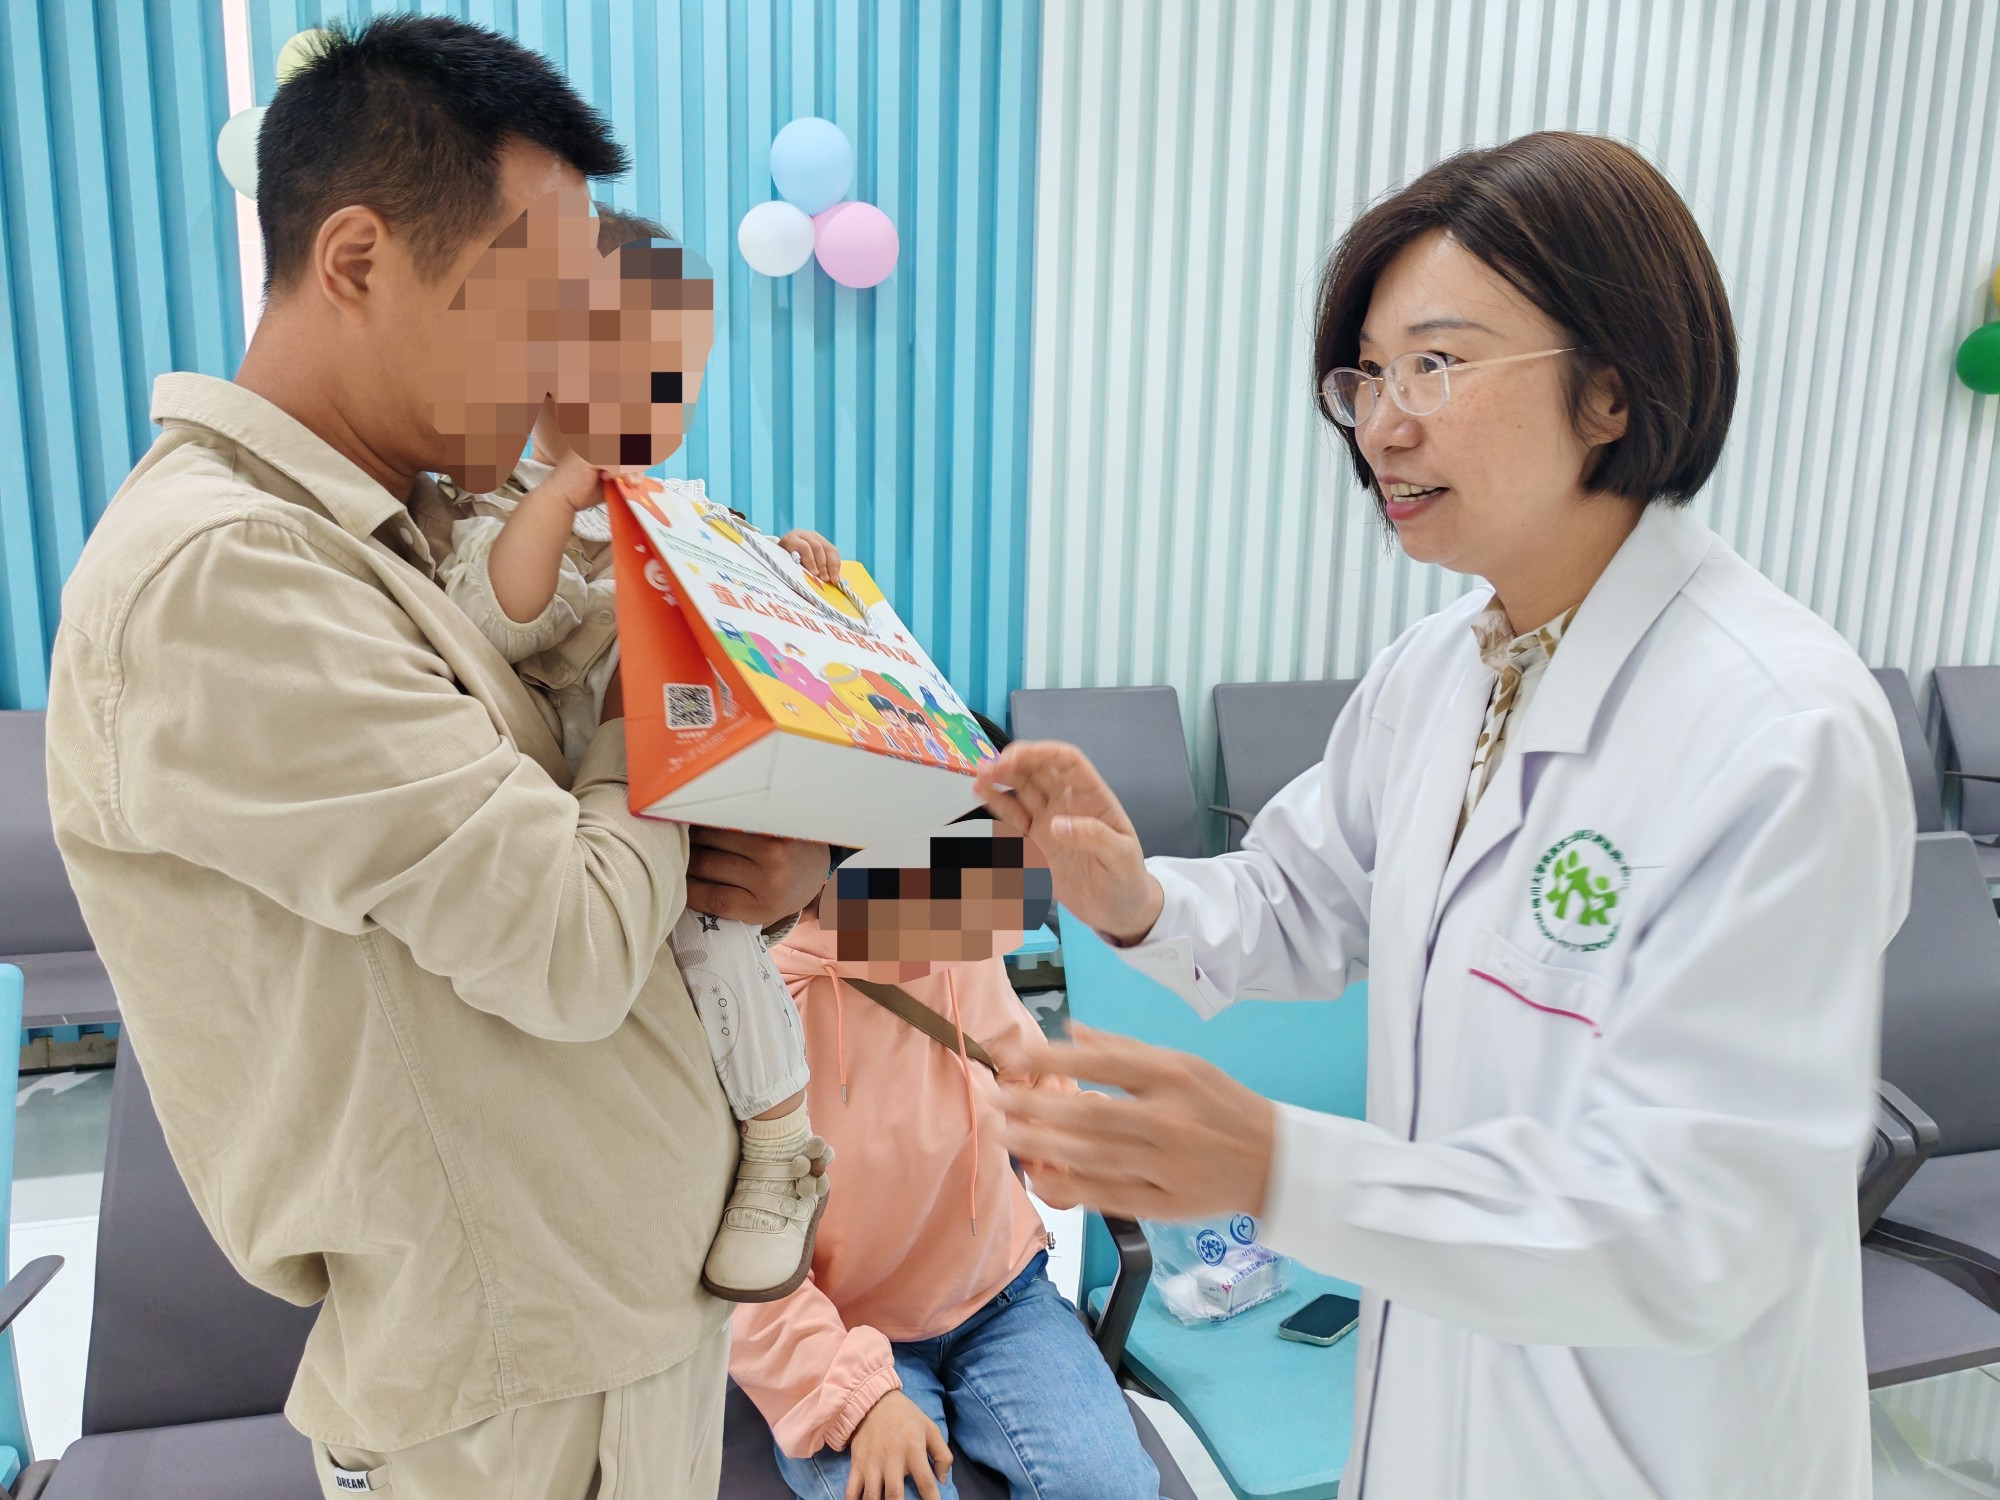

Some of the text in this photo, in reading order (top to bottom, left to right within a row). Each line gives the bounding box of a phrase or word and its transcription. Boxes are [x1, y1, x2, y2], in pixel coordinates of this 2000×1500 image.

[706, 581, 827, 636] 童心绽放
[336, 1475, 367, 1490] DREAM
